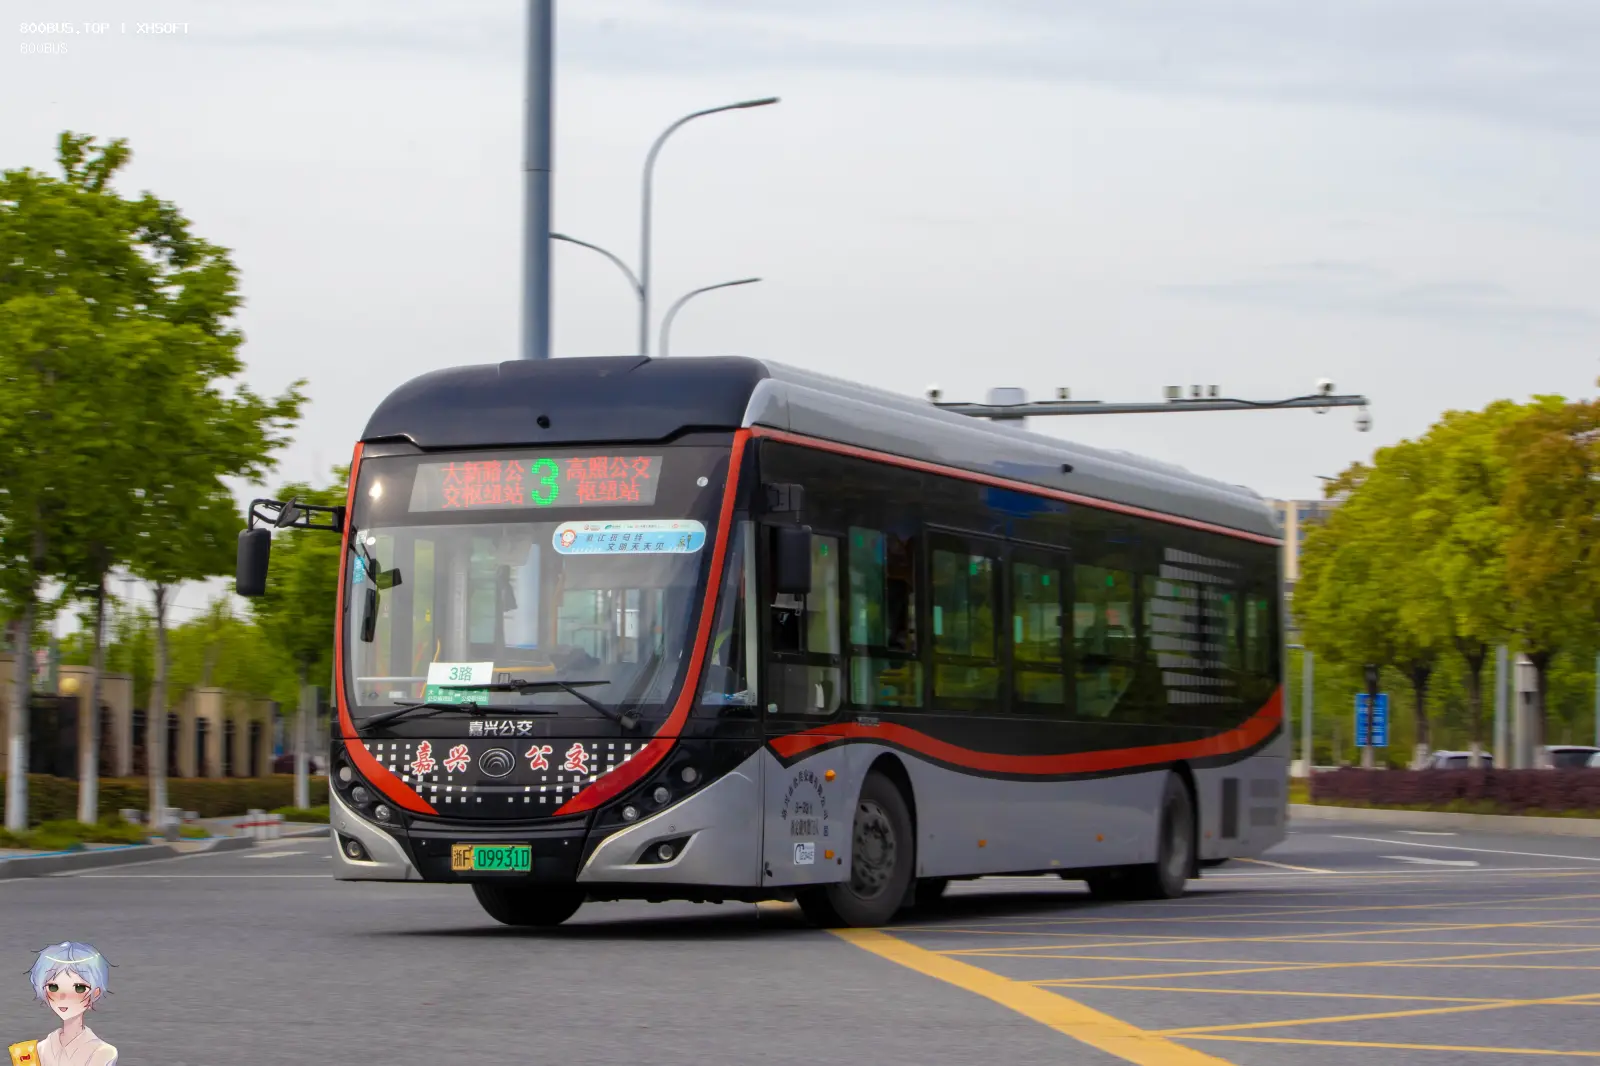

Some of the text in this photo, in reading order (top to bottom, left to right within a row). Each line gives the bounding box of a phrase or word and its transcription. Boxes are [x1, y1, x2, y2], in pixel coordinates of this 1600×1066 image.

[531, 458, 559, 505] 3
[607, 542, 665, 551] 文明天天见
[449, 666, 472, 681] 3路
[469, 720, 533, 736] 嘉兴公交
[411, 740, 590, 776] 嘉兴 公交
